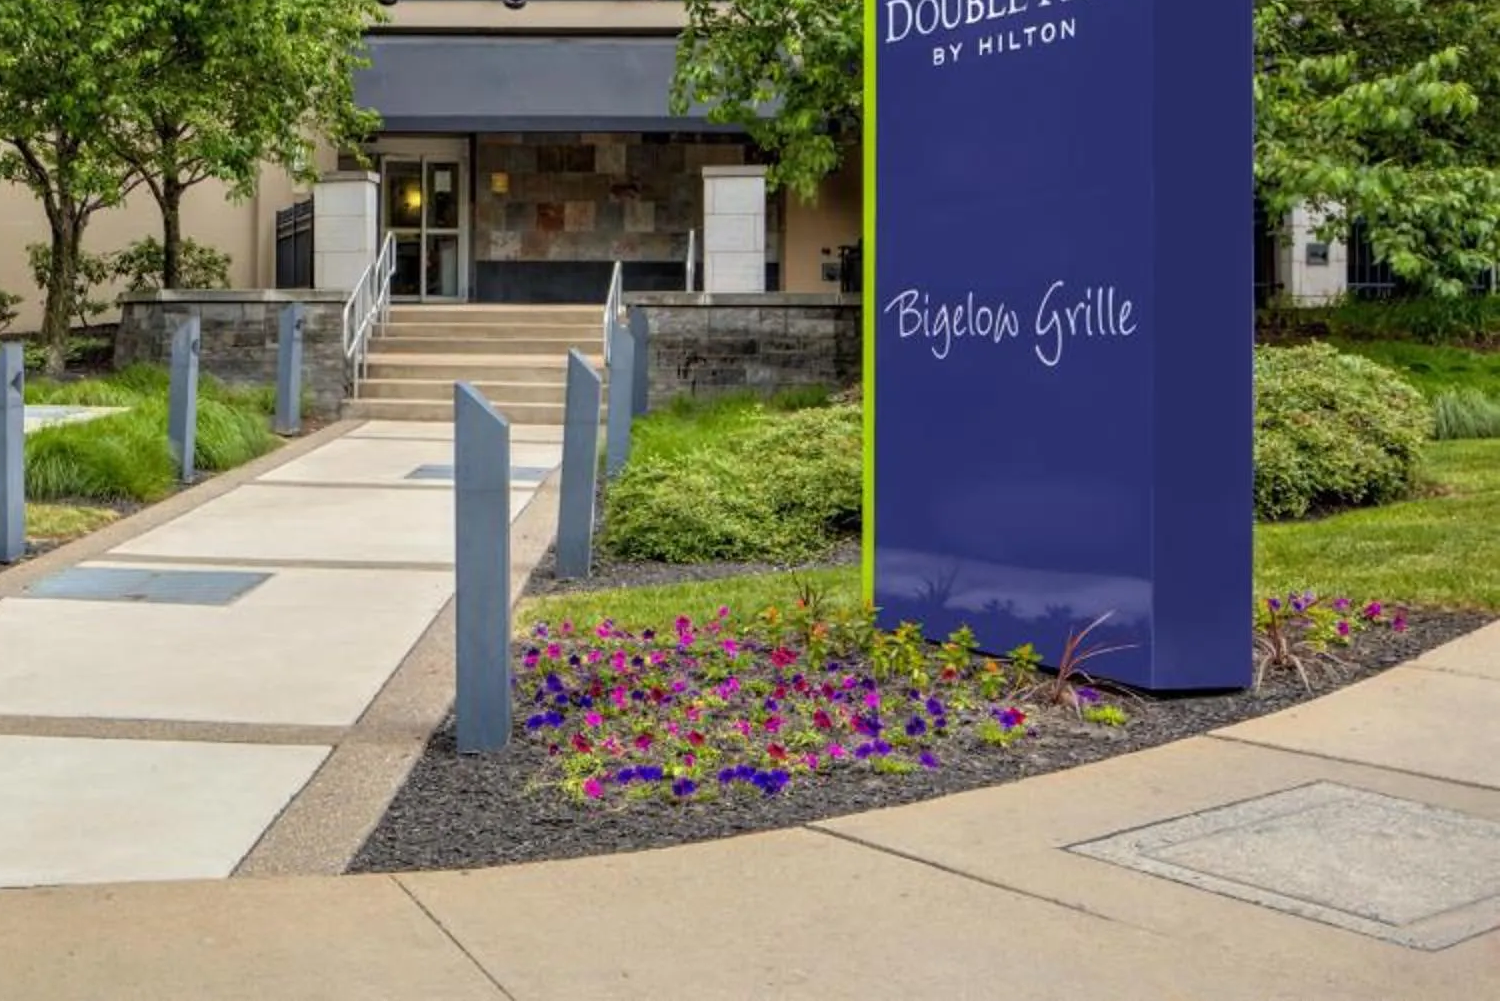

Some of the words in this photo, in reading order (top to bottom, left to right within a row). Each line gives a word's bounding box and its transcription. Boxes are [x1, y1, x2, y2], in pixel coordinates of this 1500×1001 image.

[932, 42, 964, 66] BY
[978, 17, 1077, 56] HILTON
[883, 288, 1020, 360] Bigelow
[1034, 279, 1138, 367] Grille
